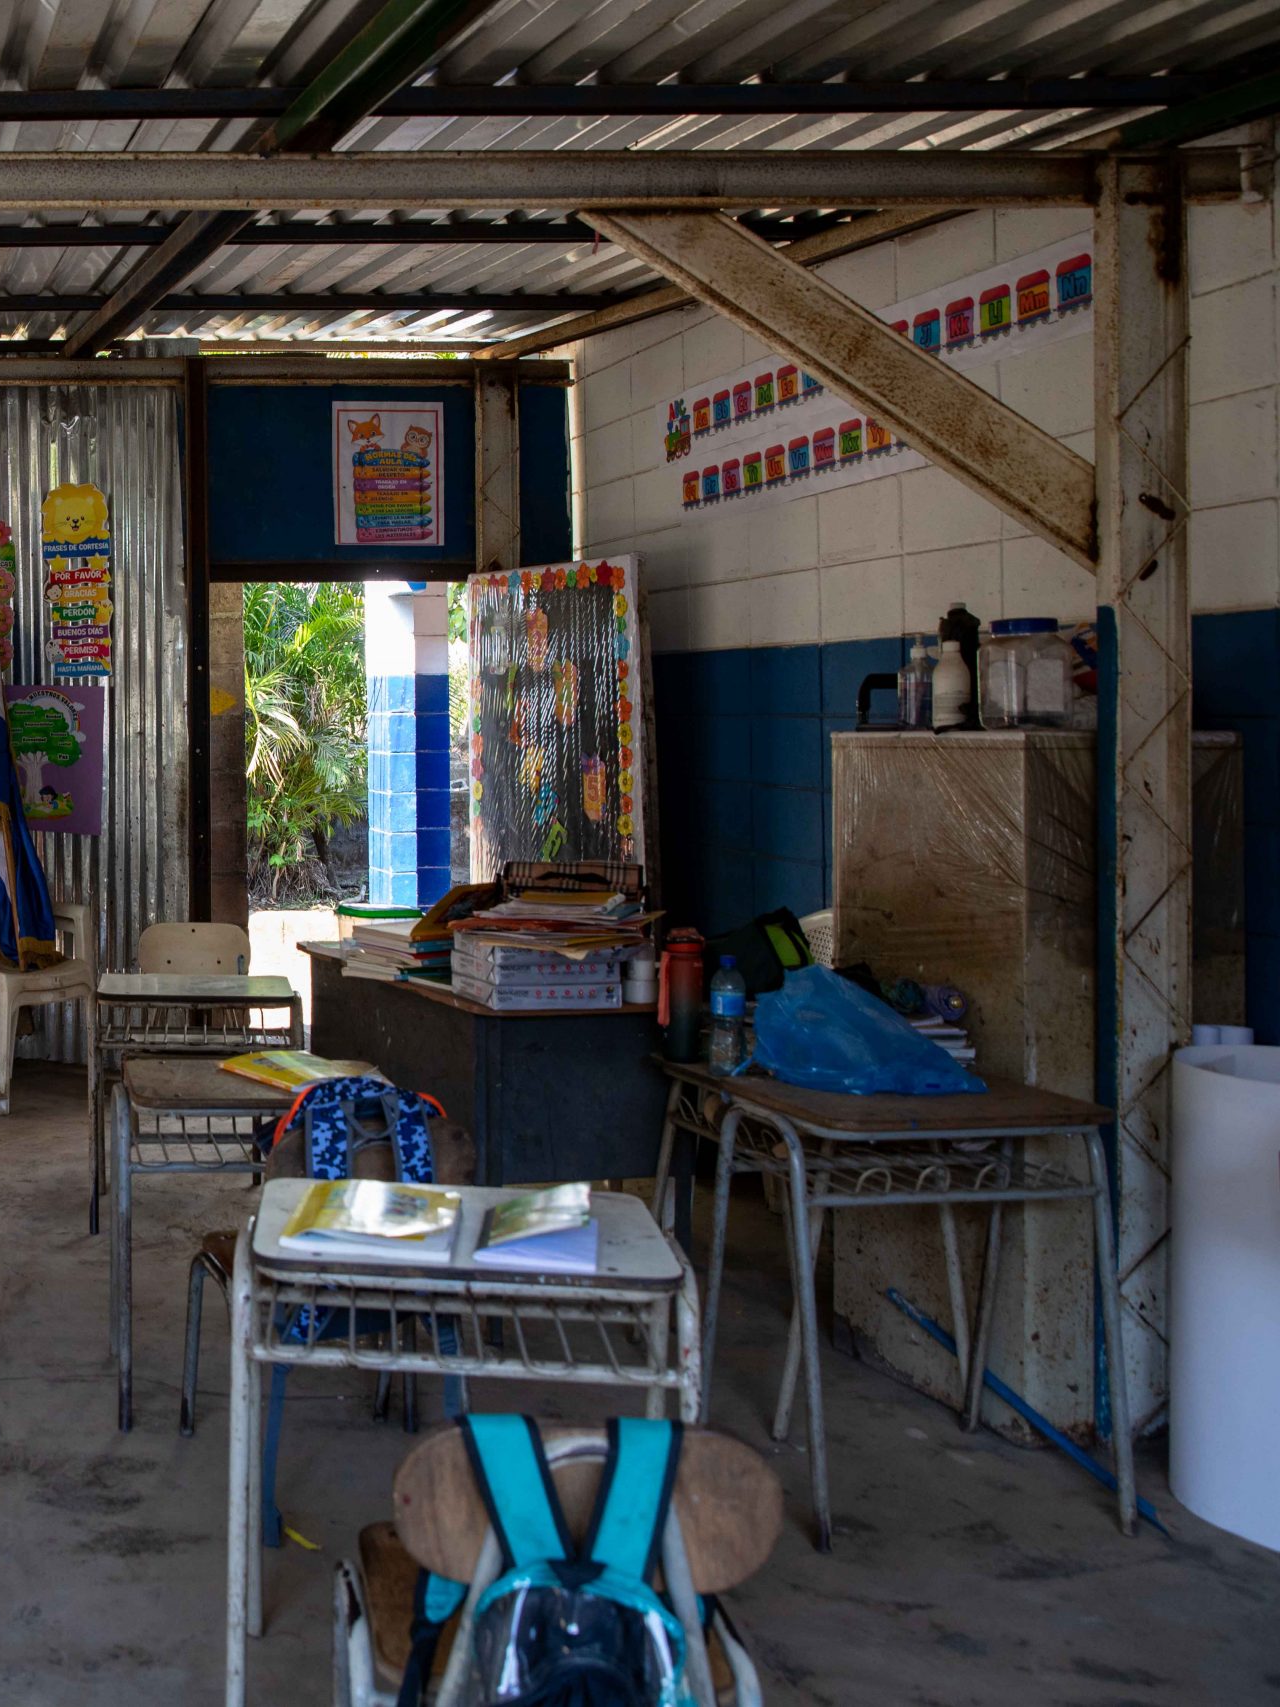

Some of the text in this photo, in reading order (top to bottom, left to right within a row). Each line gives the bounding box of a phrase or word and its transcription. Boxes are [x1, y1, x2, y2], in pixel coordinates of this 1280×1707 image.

[950, 314, 970, 339] Kk
[1020, 291, 1049, 315] Mm
[1061, 273, 1087, 302] Nn
[757, 384, 771, 406] Dd
[791, 450, 807, 470] Vv
[841, 433, 859, 455] Xx
[43, 543, 68, 552] FRASES
[78, 541, 109, 551] CORTESÍA
[55, 570, 102, 581] POR FAVOR
[63, 590, 98, 598] GRACIAS
[63, 607, 96, 618] PERDÓN
[57, 626, 104, 637] BUENOS DÍAS
[64, 645, 99, 655] PERMISO
[56, 665, 77, 673] HASTA
[586, 773, 600, 802] 5
